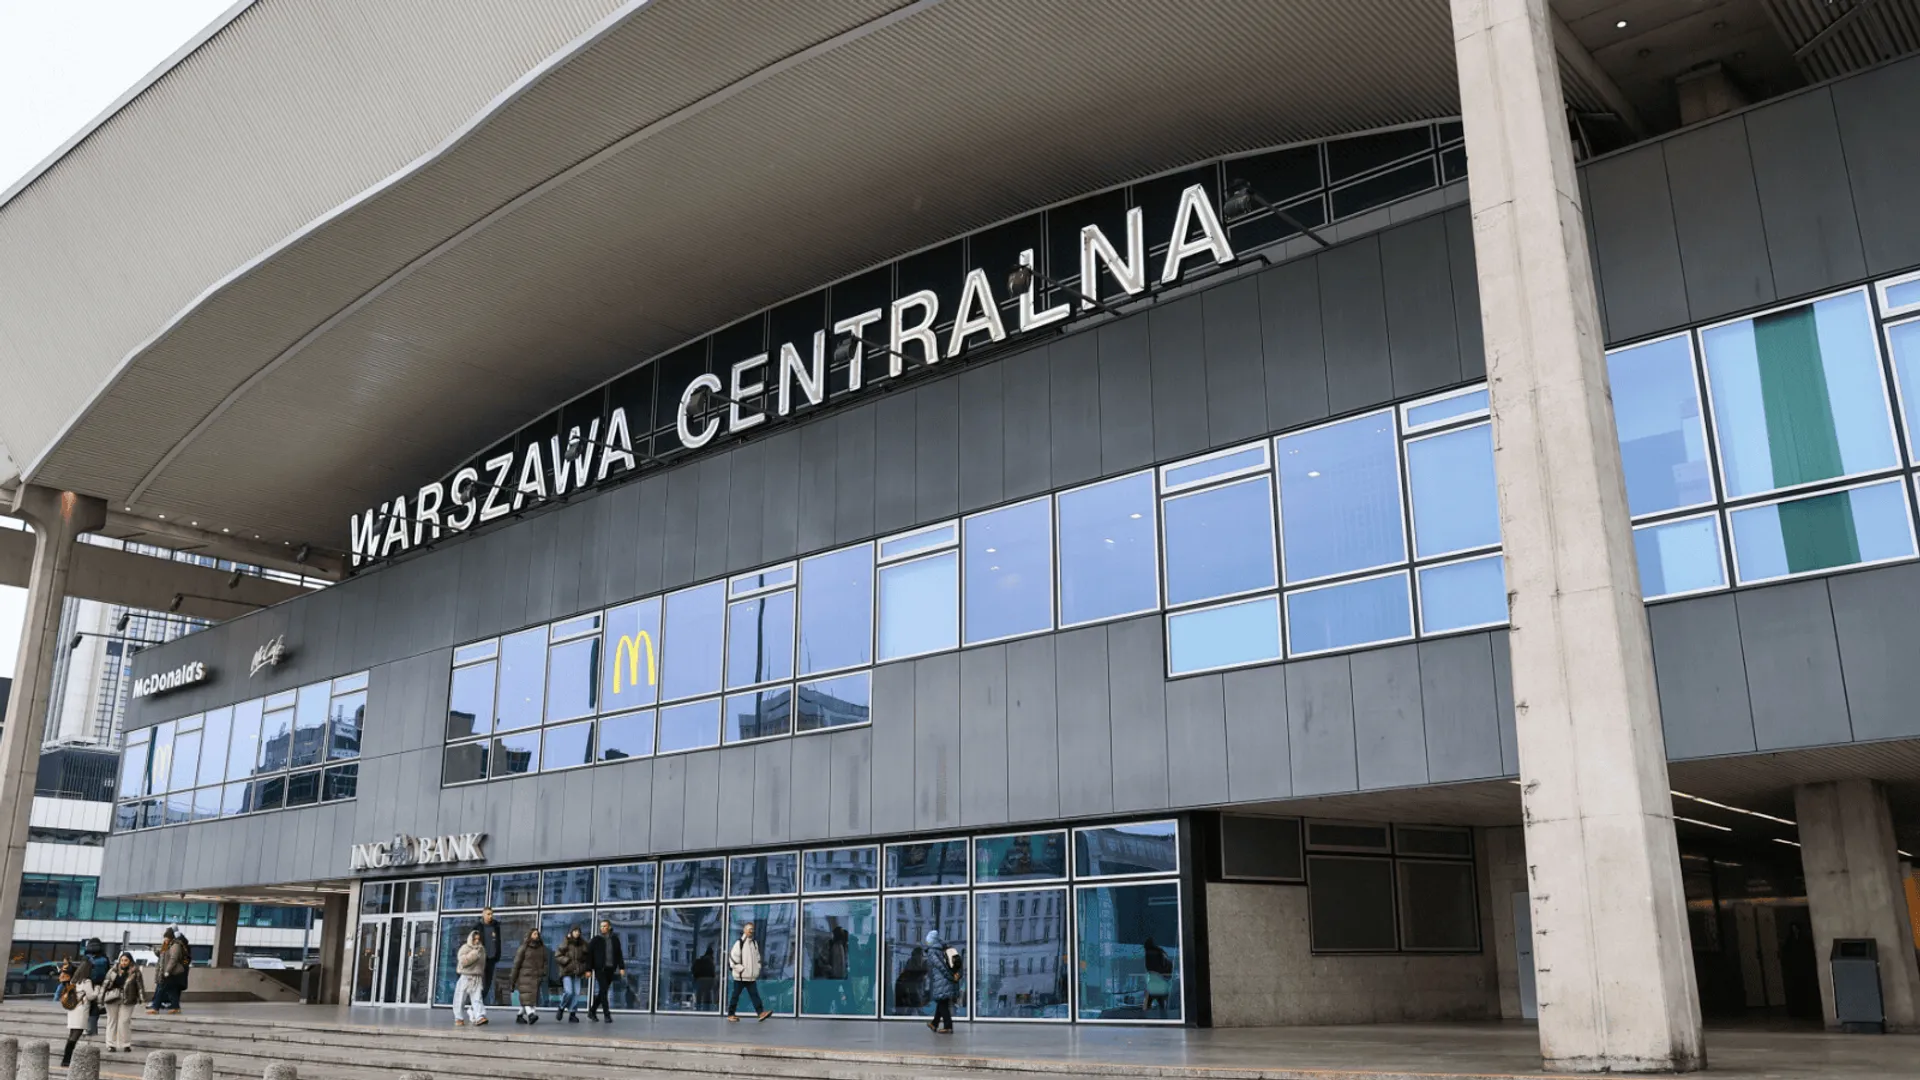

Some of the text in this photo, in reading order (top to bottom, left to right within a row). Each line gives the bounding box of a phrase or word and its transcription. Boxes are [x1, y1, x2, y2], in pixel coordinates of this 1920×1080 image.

[351, 183, 1235, 567] WARSZAWA CENTRALNA
[132, 661, 206, 699] McDonald's
[349, 832, 485, 869] ING BANK
